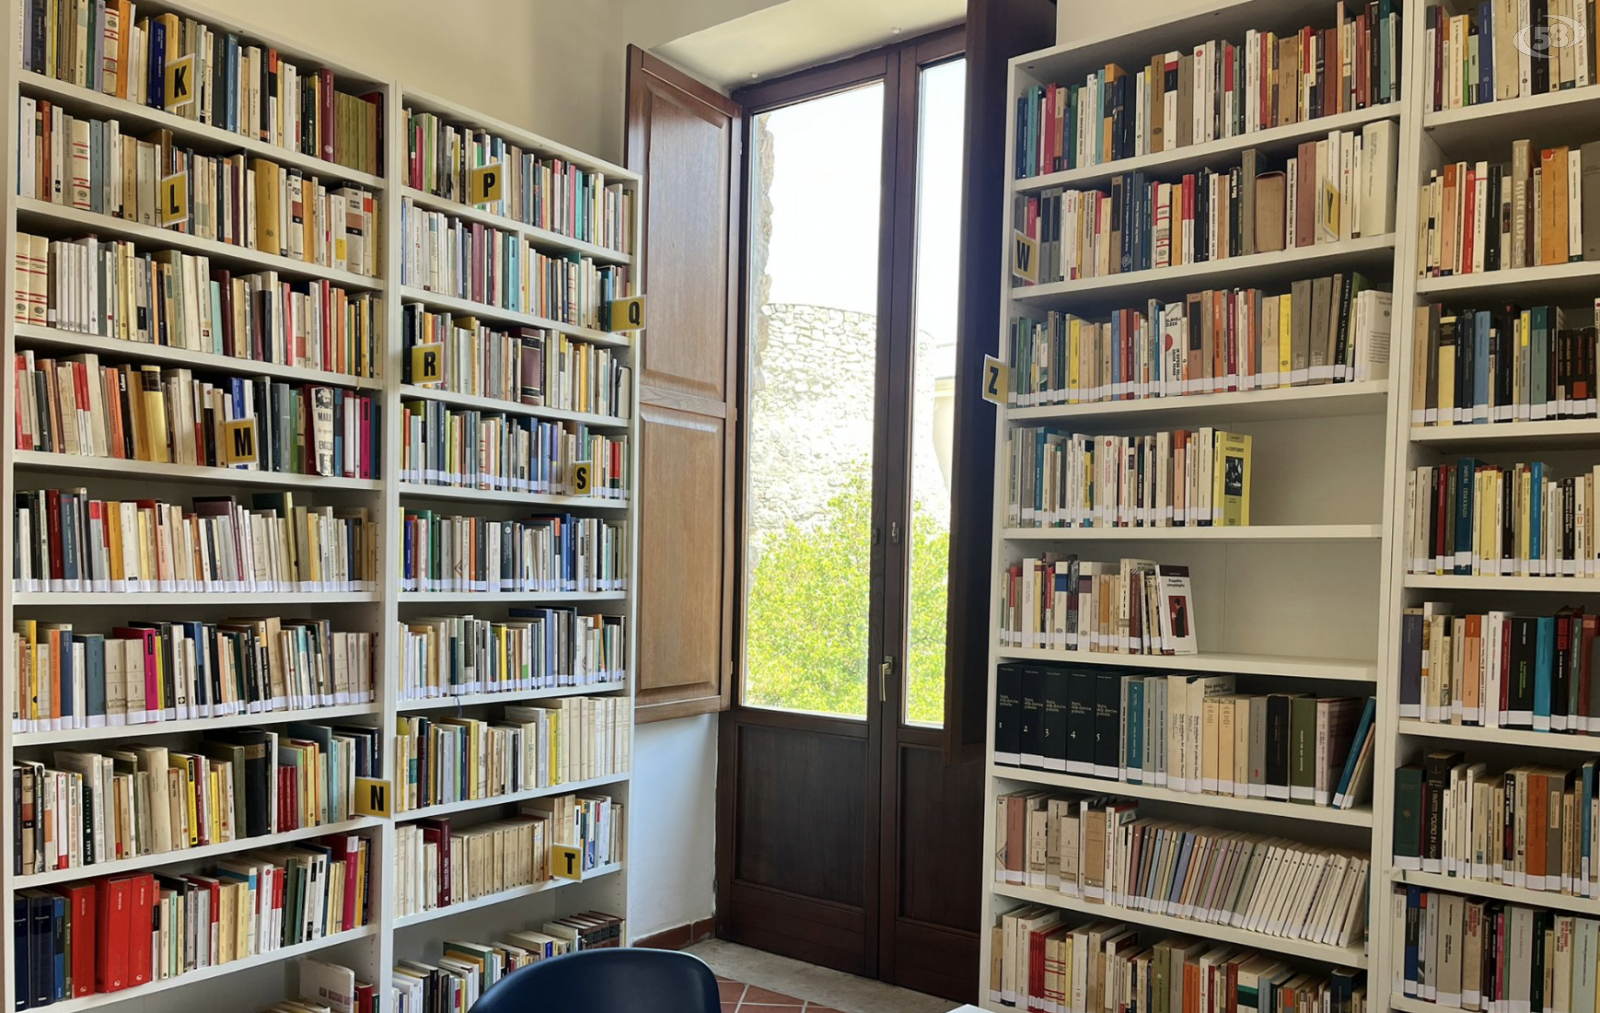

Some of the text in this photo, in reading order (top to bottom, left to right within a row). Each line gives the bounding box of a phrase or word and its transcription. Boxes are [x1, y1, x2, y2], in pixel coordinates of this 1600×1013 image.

[174, 66, 187, 98] K
[483, 173, 496, 197] P
[170, 184, 180, 215] L
[1516, 214, 1525, 241] LEADE
[1017, 240, 1031, 272] W
[629, 302, 641, 326] Q
[424, 352, 436, 377] R
[989, 366, 999, 396] Z
[234, 427, 252, 457] M
[577, 467, 587, 489] S
[1044, 728, 1050, 738] 3
[1070, 731, 1076, 740] 4
[1095, 733, 1100, 742] 5
[371, 785, 385, 812] N
[564, 852, 575, 874] T
